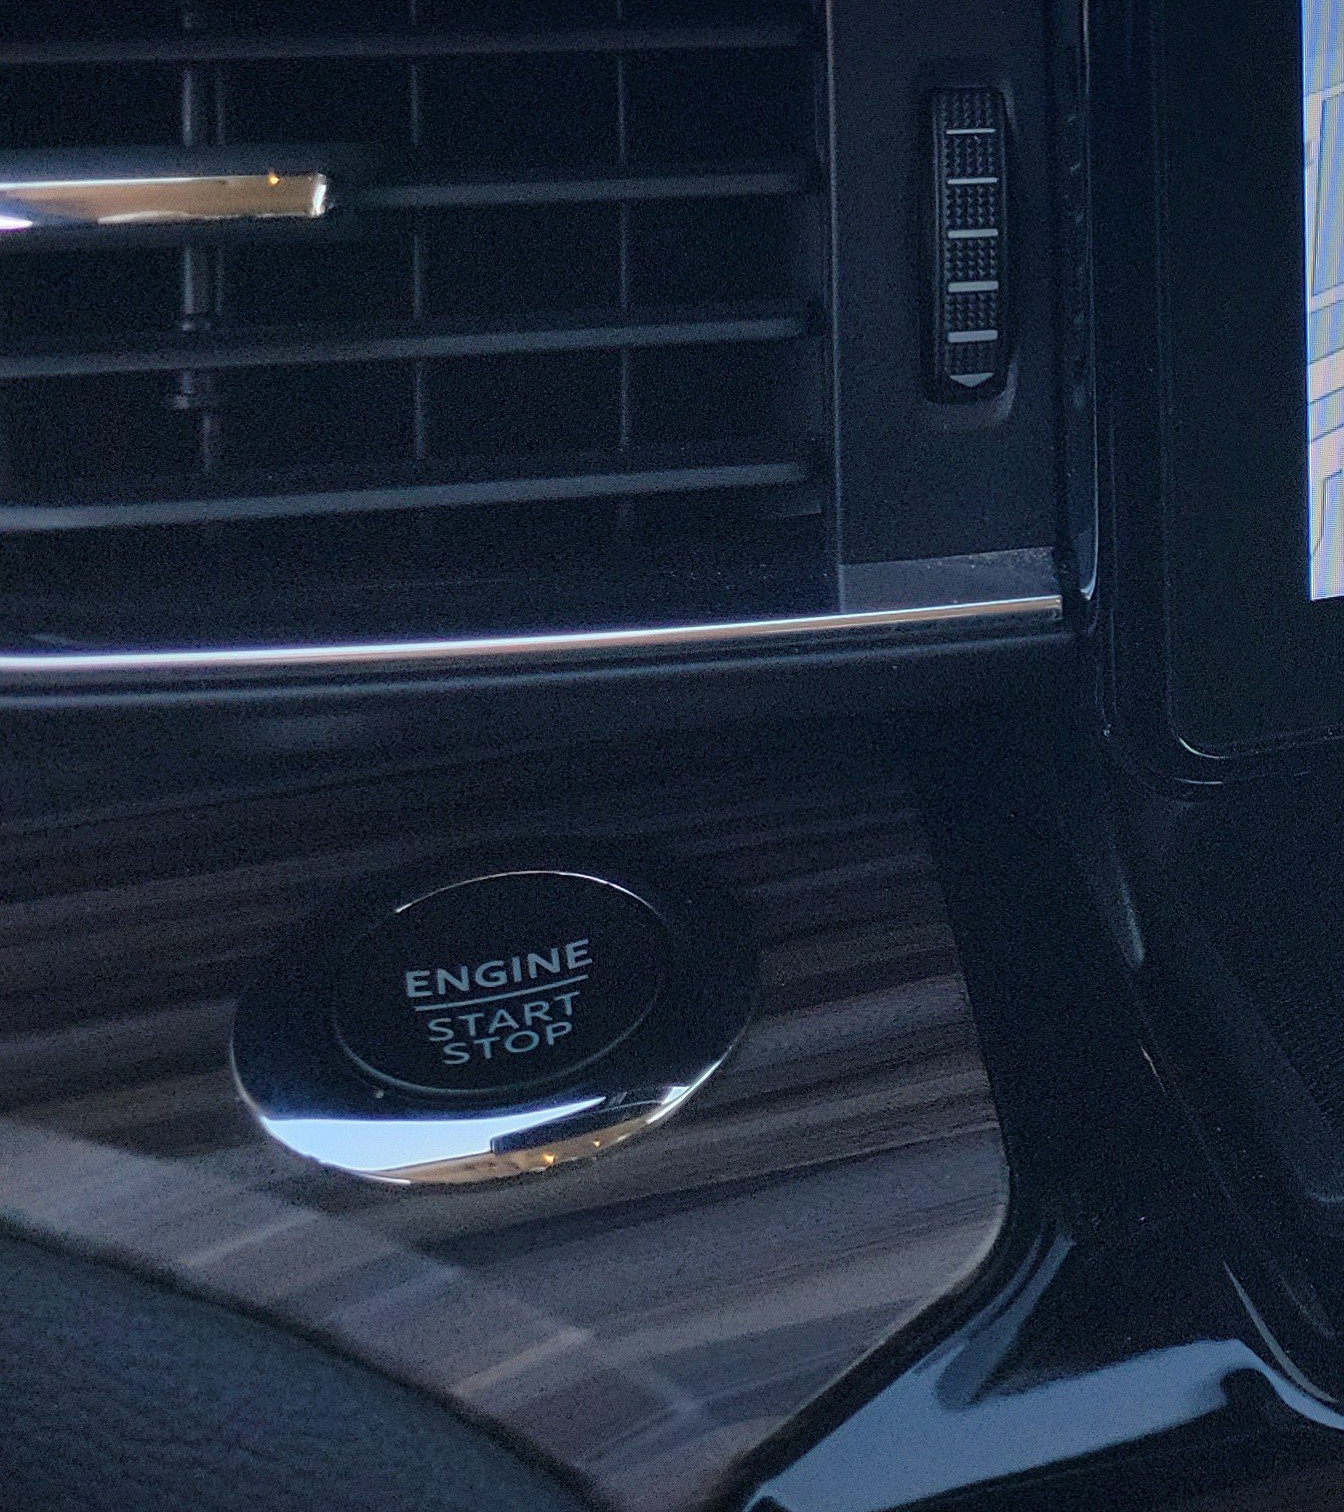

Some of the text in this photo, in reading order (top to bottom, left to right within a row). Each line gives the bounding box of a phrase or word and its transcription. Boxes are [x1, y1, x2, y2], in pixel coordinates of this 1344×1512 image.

[405, 939, 593, 999] ENGINE
[428, 991, 580, 1042] START
[443, 1021, 573, 1065] STOP
